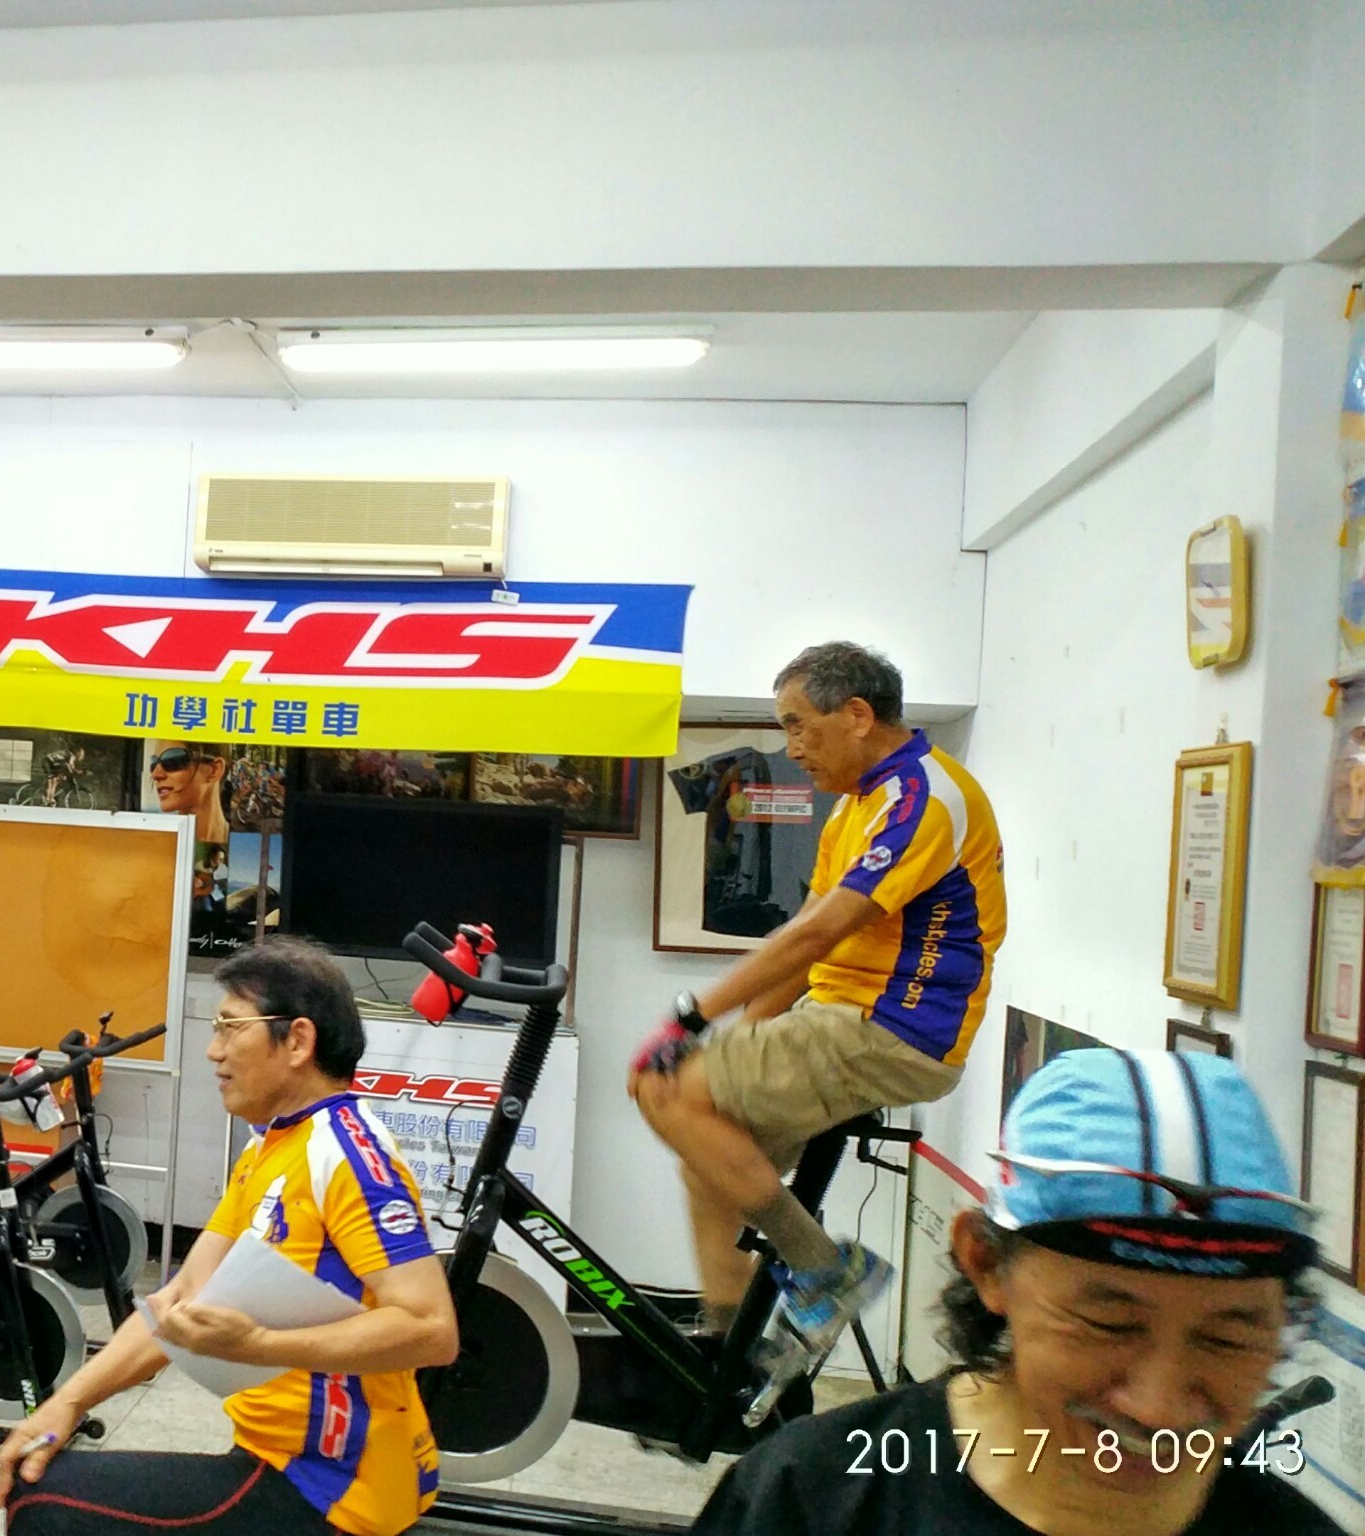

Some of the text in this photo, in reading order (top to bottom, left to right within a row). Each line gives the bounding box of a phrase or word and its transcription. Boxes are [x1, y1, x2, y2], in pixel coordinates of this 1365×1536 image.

[123, 692, 360, 737] 功學社單車
[518, 1215, 636, 1311] ROBIX
